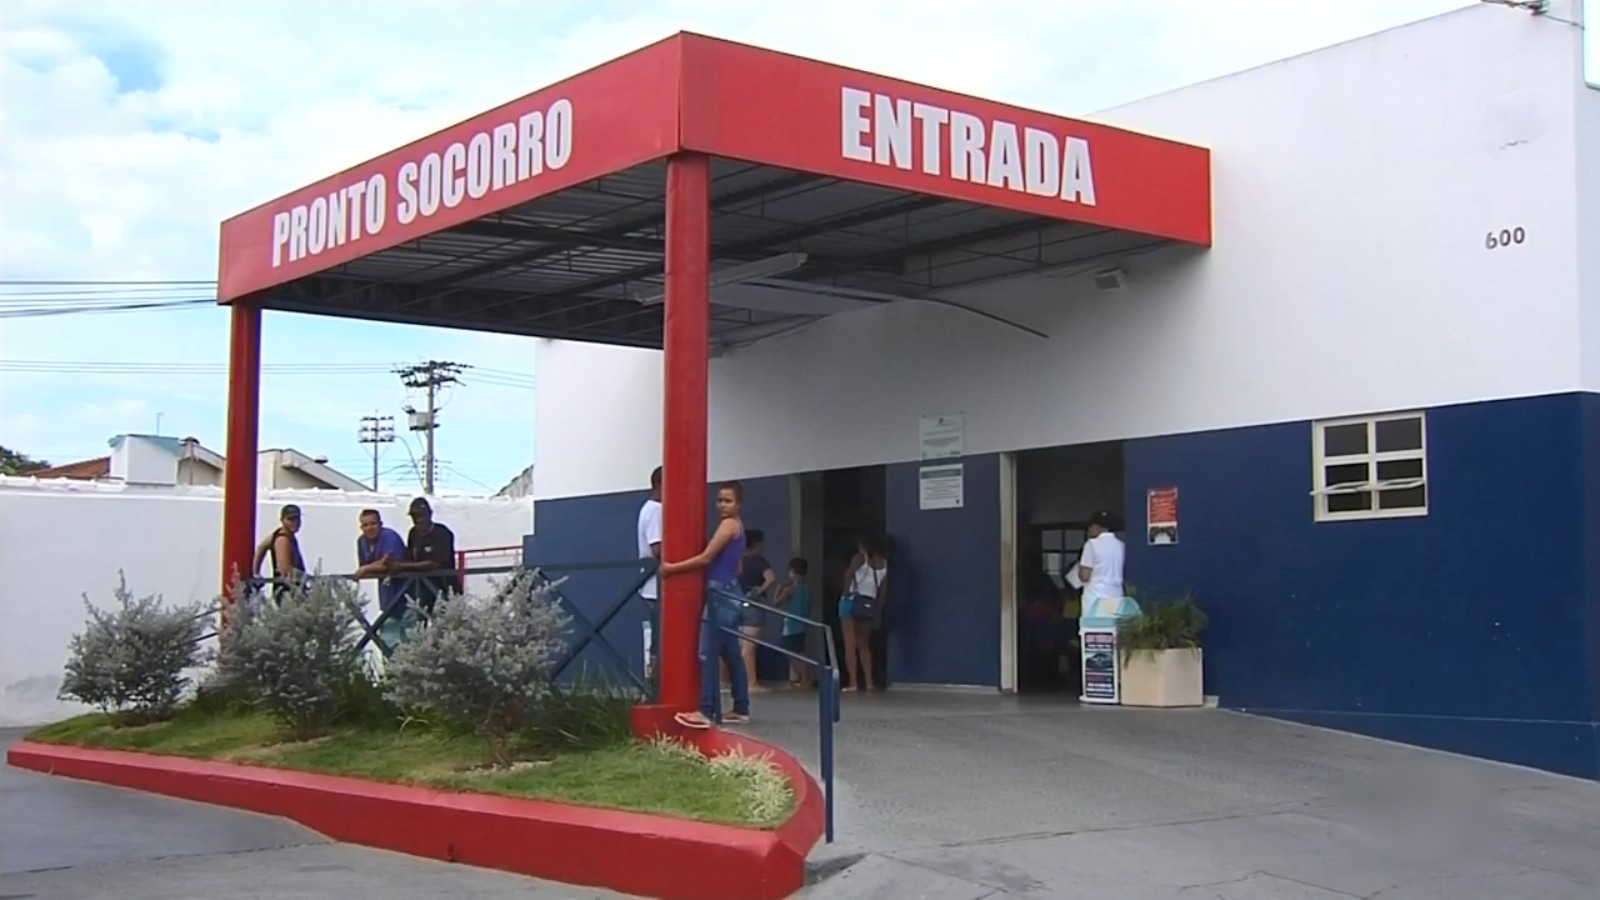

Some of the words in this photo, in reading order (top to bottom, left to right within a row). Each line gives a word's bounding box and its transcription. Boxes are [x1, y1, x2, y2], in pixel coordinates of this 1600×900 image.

[272, 173, 387, 268] PRONTO
[397, 98, 573, 225] SOCORRO
[841, 86, 1096, 206] ENTRADA
[1485, 226, 1526, 250] 600
